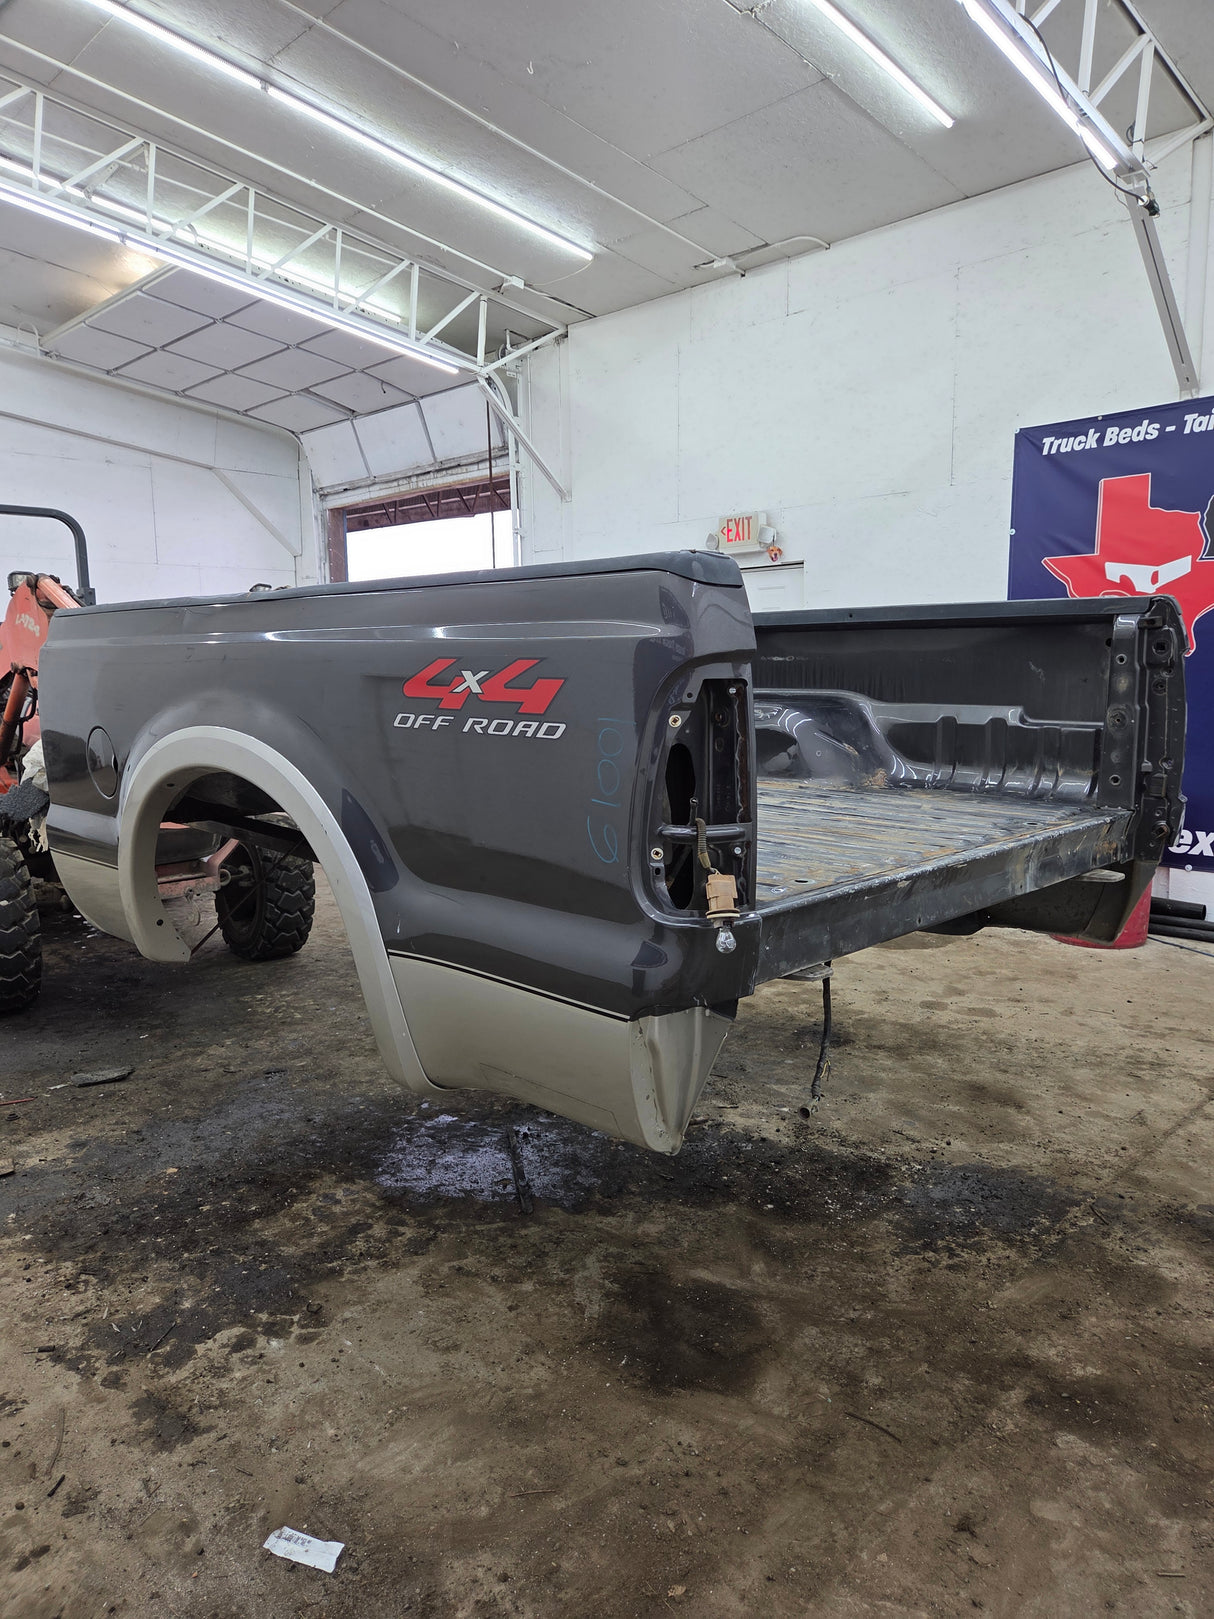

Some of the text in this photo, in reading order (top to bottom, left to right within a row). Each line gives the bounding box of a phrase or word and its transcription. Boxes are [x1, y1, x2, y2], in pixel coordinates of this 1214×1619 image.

[1042, 428, 1101, 456] Truck
[1103, 419, 1160, 447] Beds
[726, 516, 752, 543] EXIT
[393, 712, 567, 740] OFF ROAD
